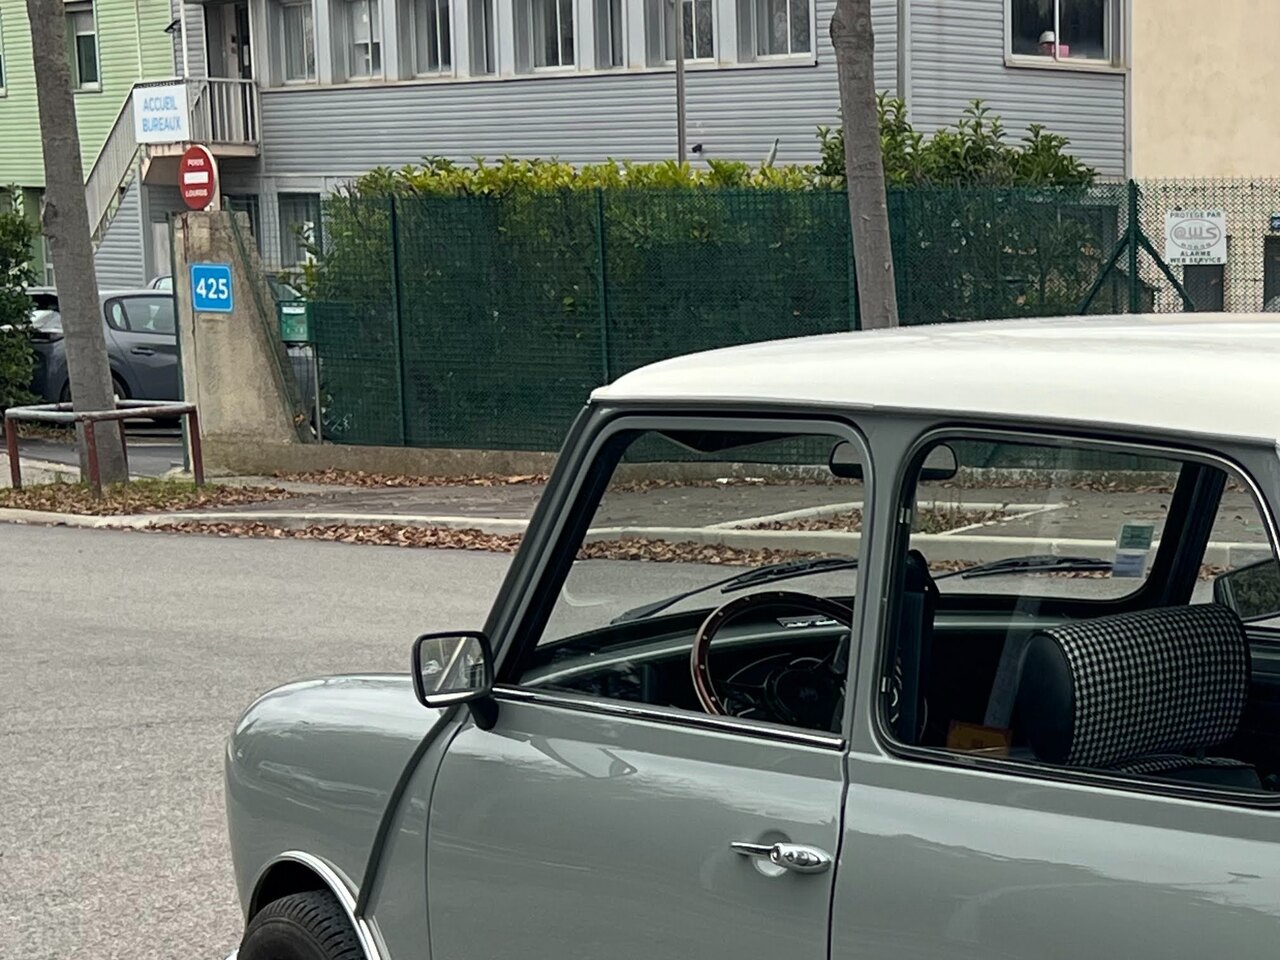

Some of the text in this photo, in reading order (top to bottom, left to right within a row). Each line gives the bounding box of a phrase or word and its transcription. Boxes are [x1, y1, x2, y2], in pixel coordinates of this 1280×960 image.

[143, 95, 178, 112] ACCUEIL
[142, 116, 182, 133] BUREAUX
[185, 188, 208, 198] LOURDS
[196, 277, 229, 300] 425
